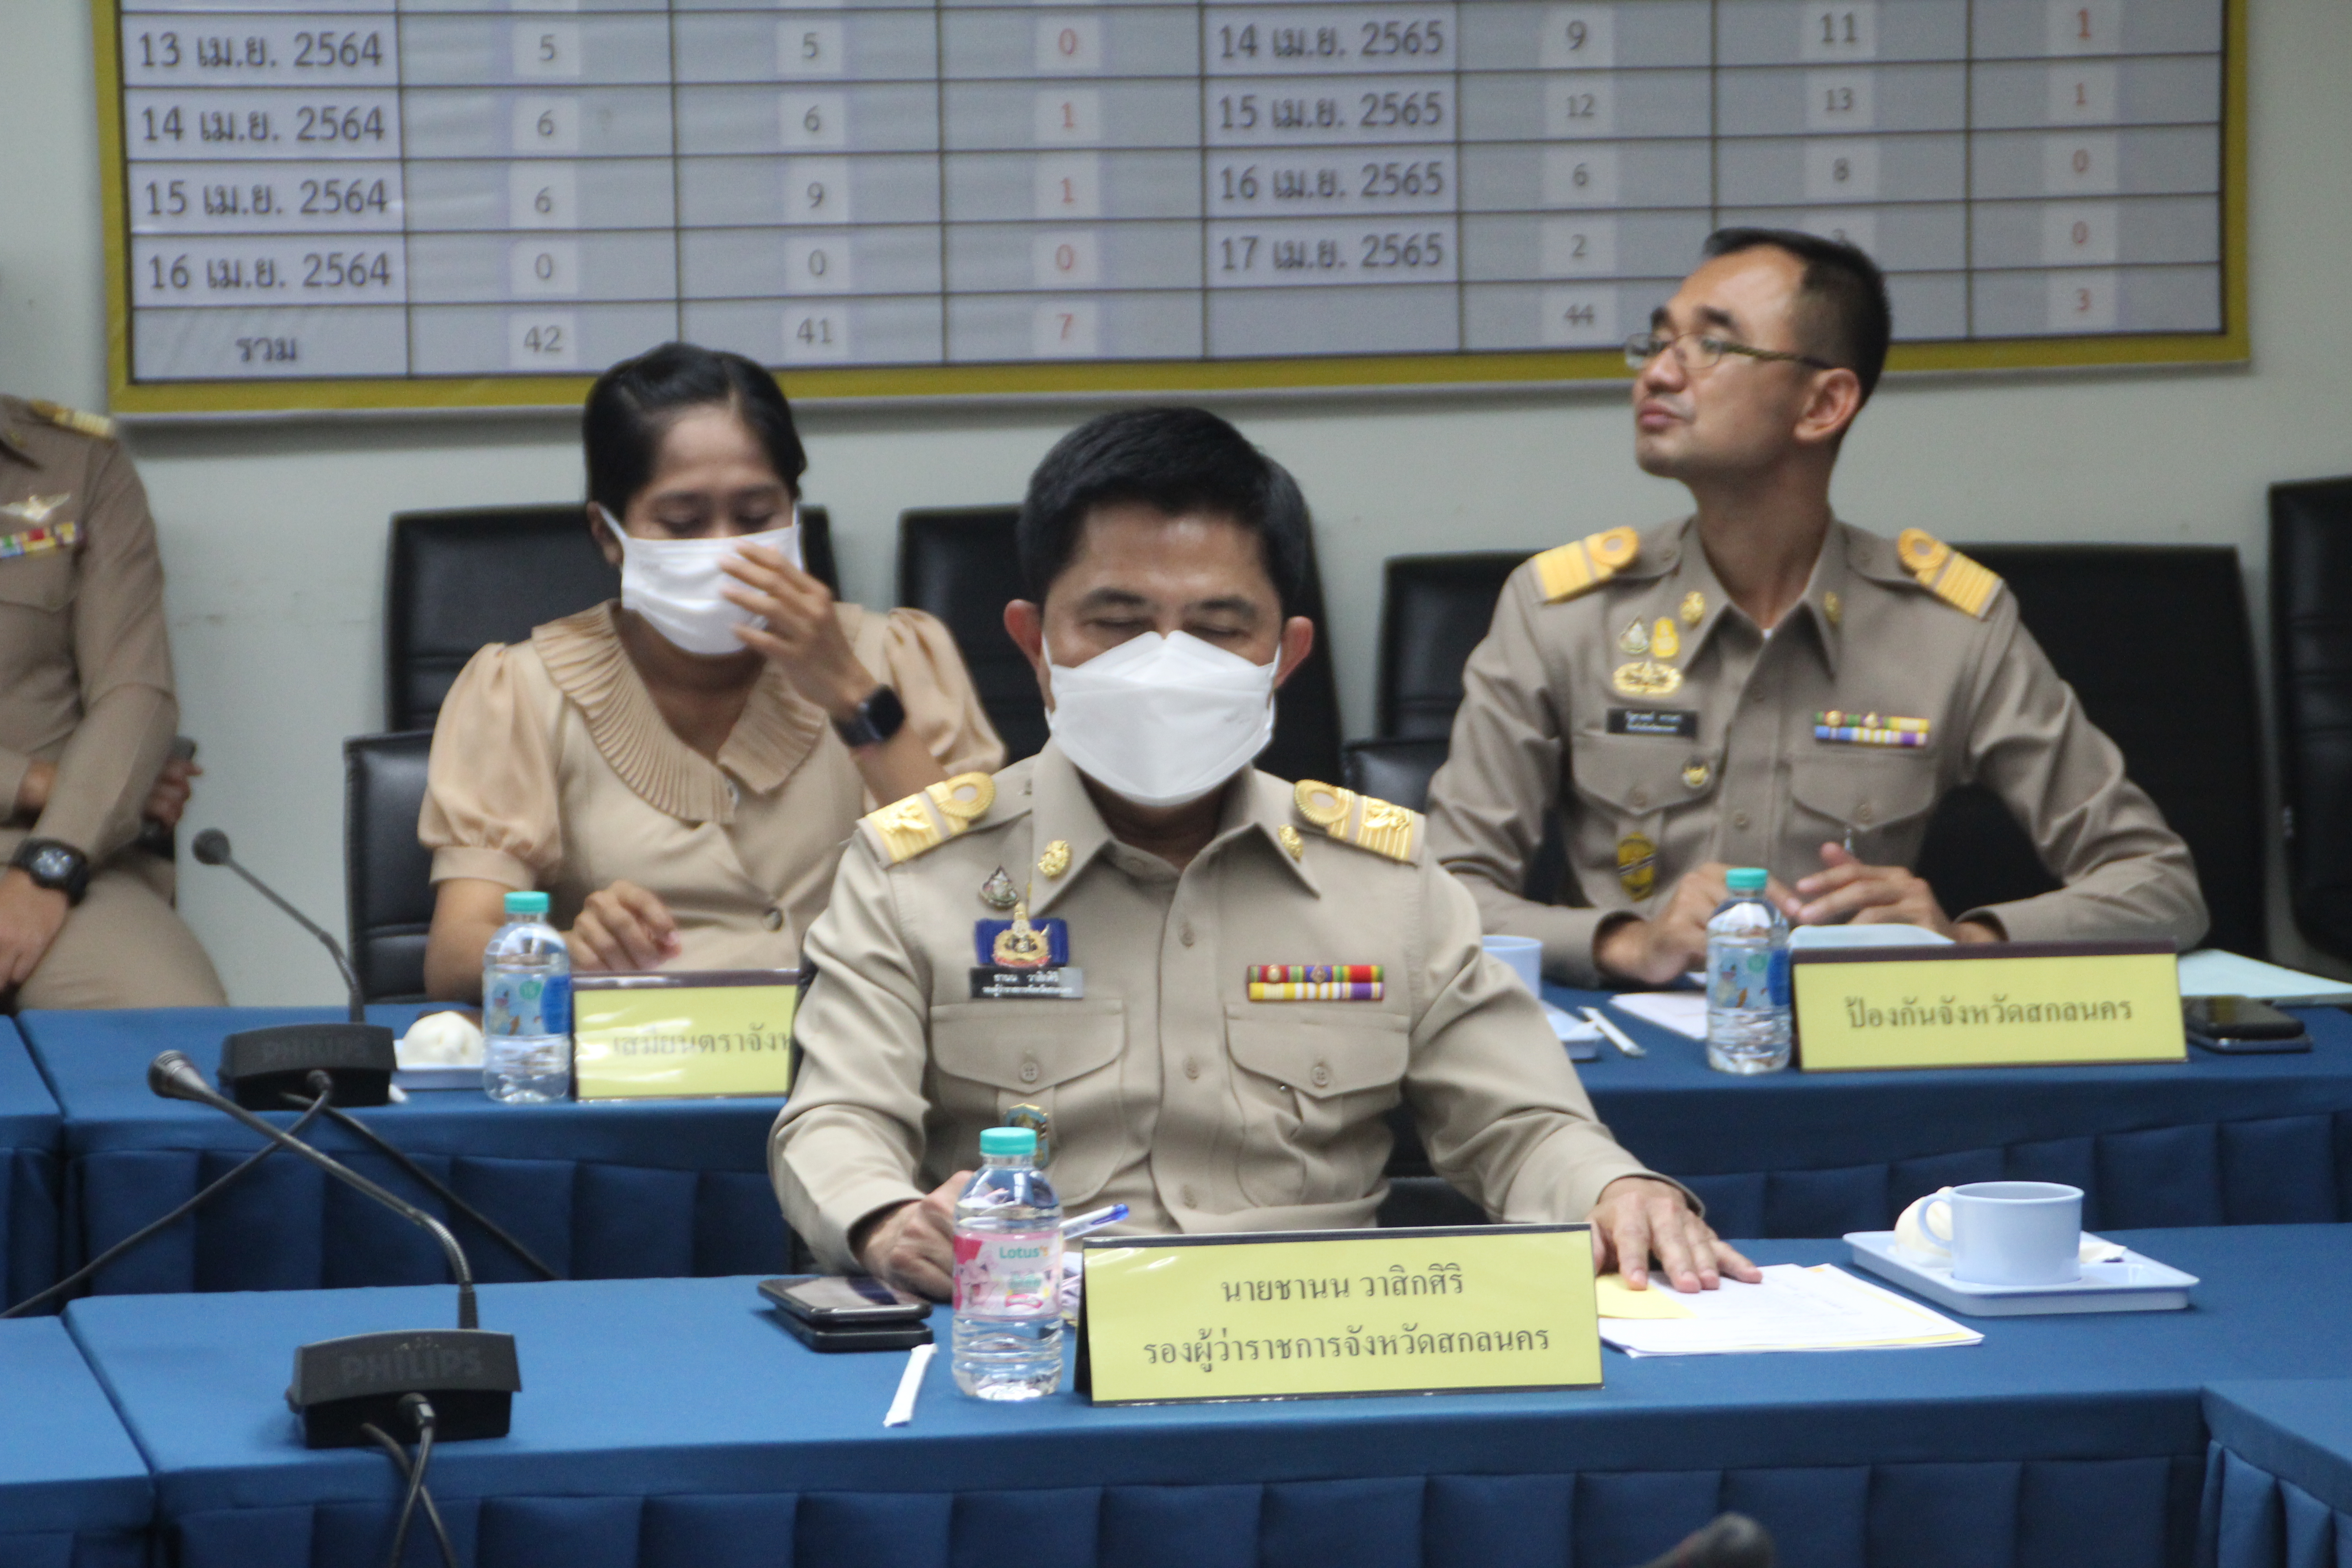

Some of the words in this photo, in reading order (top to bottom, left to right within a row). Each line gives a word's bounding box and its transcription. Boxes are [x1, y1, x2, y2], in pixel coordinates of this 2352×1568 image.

[1566, 19, 1588, 51] 9
[1819, 11, 1858, 46] 11
[2077, 8, 2092, 41] 1
[139, 31, 181, 69] 13
[196, 36, 277, 70] เม.ย.
[293, 30, 383, 69] 2564
[539, 33, 558, 63] 5
[802, 31, 820, 61] 5
[1058, 28, 1078, 57] 0
[1220, 24, 1259, 59] 14
[1272, 26, 1346, 59] เม.ย.
[1360, 20, 1444, 58] 2565
[1566, 92, 1596, 119] 12
[1825, 87, 1854, 113] 13
[2075, 82, 2087, 108] 1
[142, 105, 185, 142] 14
[199, 111, 279, 144] เม.ย.
[296, 105, 386, 143] 2564
[536, 109, 555, 139] 6
[802, 105, 822, 134] 6
[1061, 102, 1075, 130] 1
[1219, 93, 1259, 131] 15
[1272, 98, 1345, 130] เม.ย.
[1359, 91, 1443, 129] 2565
[1571, 162, 1590, 189] 6
[2071, 148, 2090, 176] 0
[807, 181, 826, 209] 9
[1060, 177, 1075, 205] 1
[1220, 166, 1259, 201] 16
[1273, 169, 1346, 200] เม.ย.
[1361, 160, 1444, 200] 2565
[145, 179, 188, 217] 15
[202, 184, 283, 217] เม.ย.
[299, 178, 388, 216] 2564
[534, 186, 554, 215] 6
[1570, 233, 1588, 261] 2
[2071, 220, 2089, 247] 0
[807, 248, 828, 279] 0
[1055, 244, 1075, 273] 0
[1220, 235, 1260, 273] 17
[1273, 239, 1346, 271] เม.ย.
[1360, 232, 1444, 269] 2565
[148, 254, 191, 291] 16
[206, 258, 286, 291] เม.ย.
[302, 251, 391, 289] 2564
[534, 252, 555, 283] 0
[1563, 304, 1596, 327] 44
[2077, 288, 2092, 314] 3
[523, 325, 562, 354] 42
[796, 317, 832, 345] 41
[1059, 313, 1074, 340] 7
[235, 336, 299, 364] รวม
[1845, 994, 2133, 1030] ป้องกันจังหวัดสกลนคร
[1224, 1277, 1350, 1303] นายชานน
[1359, 1261, 1463, 1298] วาสิกศิริ
[1143, 1322, 1549, 1374] รองผู้ว่าราชการจังหวัดสกลนคร
[340, 1346, 483, 1386] PHILIPS
